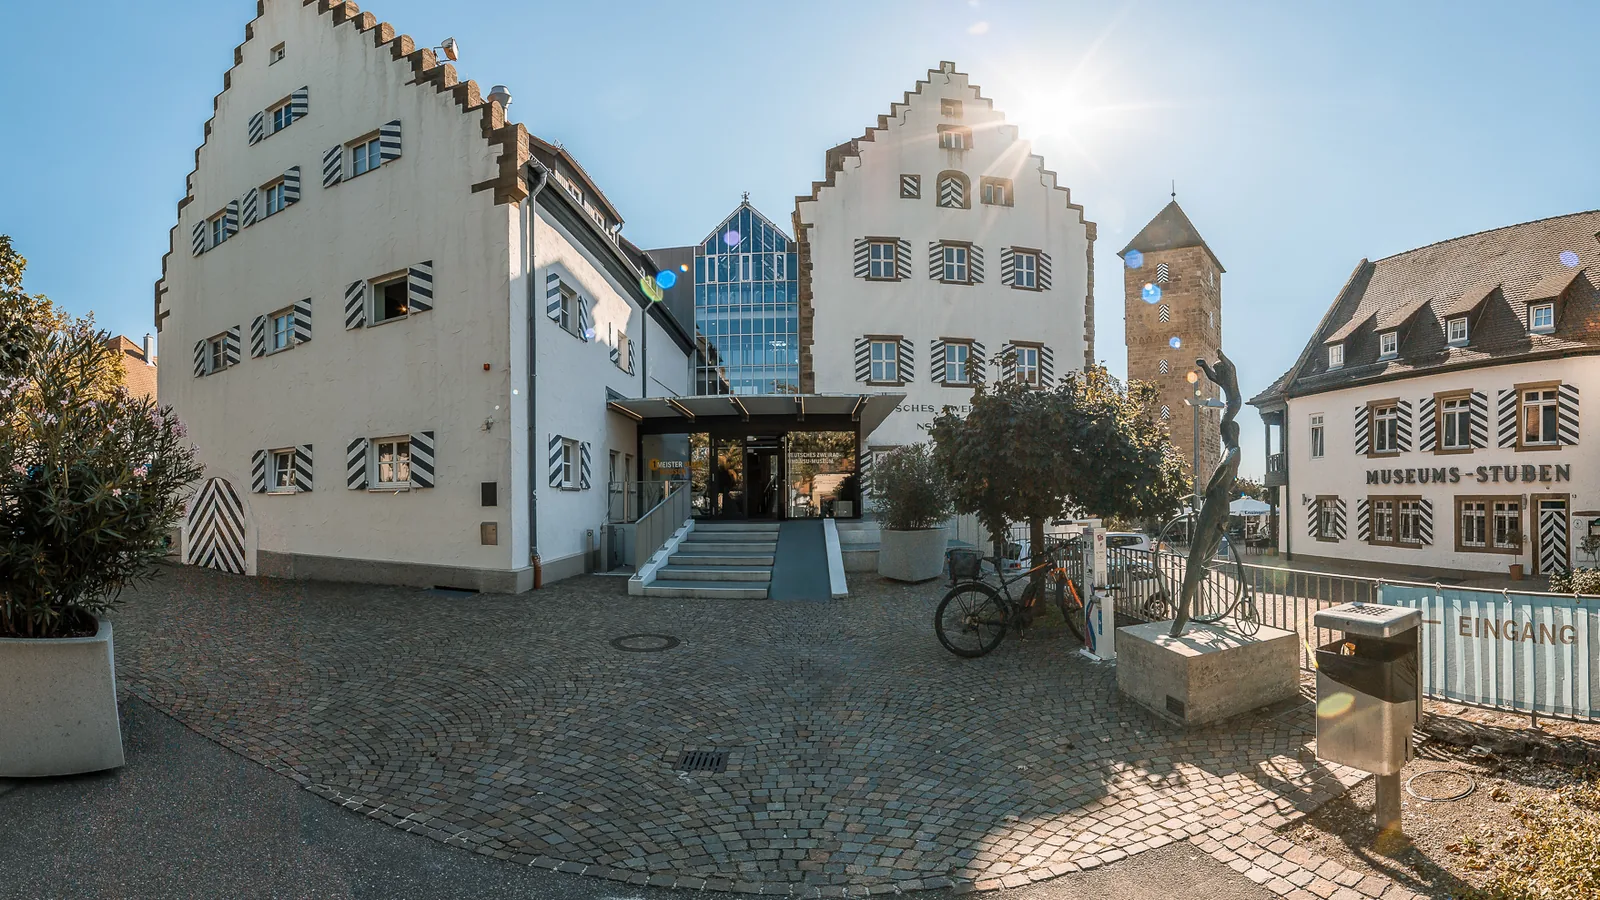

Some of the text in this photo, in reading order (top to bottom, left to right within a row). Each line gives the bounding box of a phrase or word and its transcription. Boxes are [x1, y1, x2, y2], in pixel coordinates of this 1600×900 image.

[916, 422, 934, 431] NS
[657, 460, 683, 468] MEISTER
[1366, 464, 1571, 485] MUSEUMS-STUBEN
[1459, 615, 1576, 646] EINGANG
